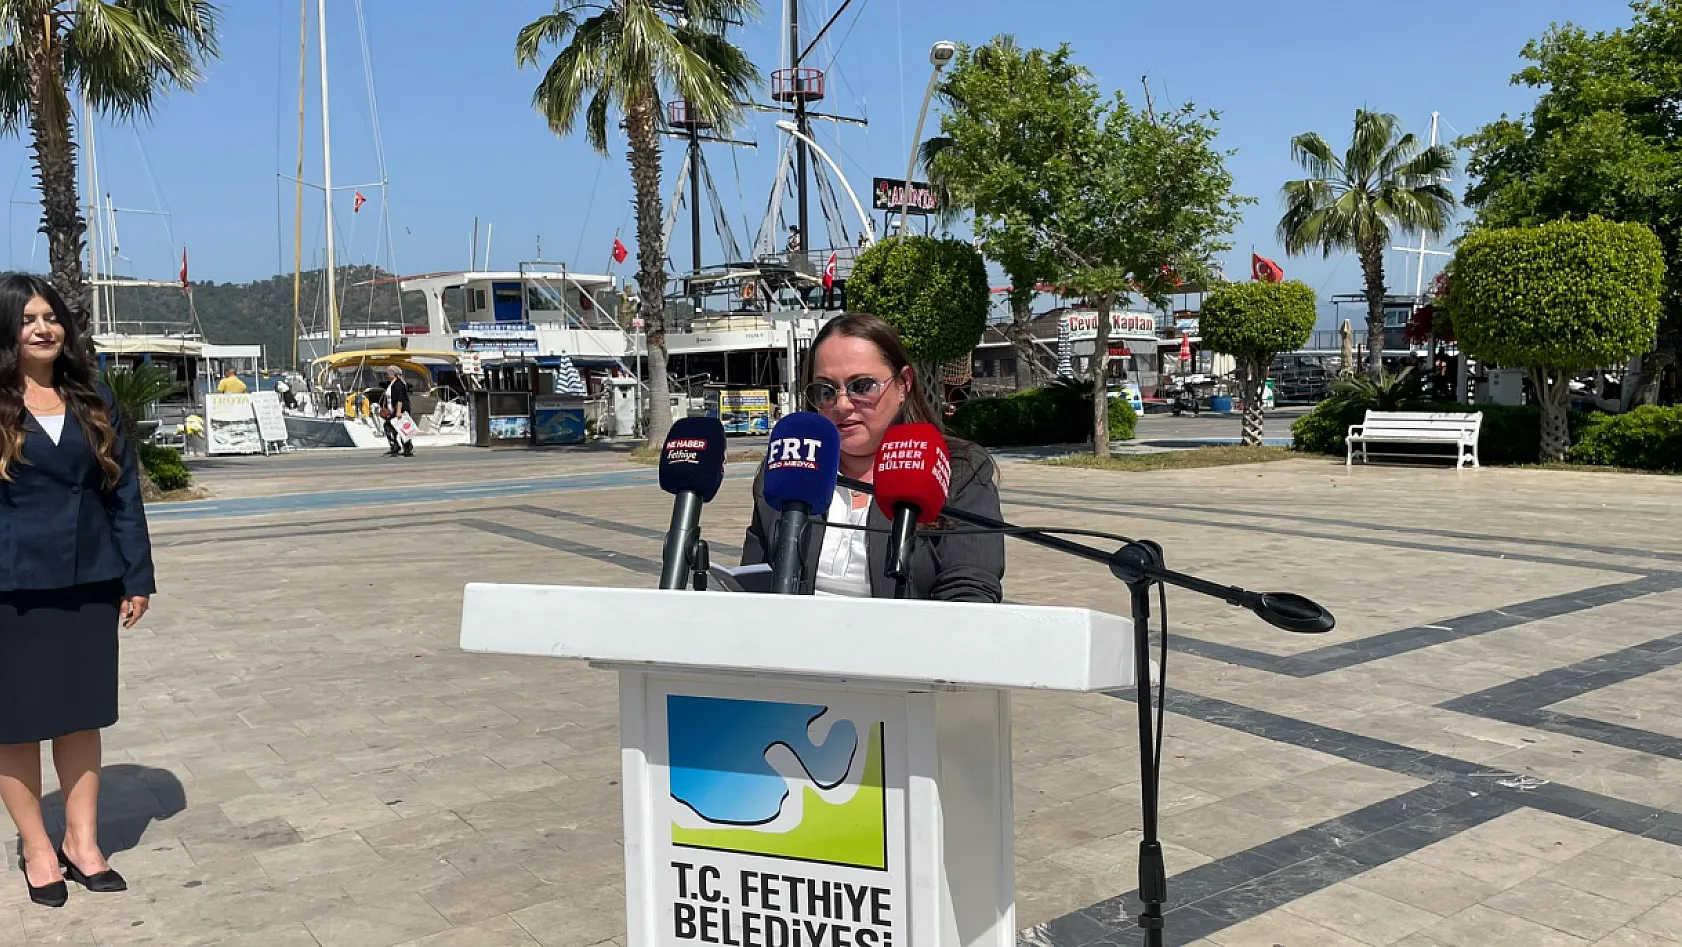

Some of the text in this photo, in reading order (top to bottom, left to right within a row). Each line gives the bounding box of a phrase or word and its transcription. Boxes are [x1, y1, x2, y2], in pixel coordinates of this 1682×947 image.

[677, 440, 705, 448] HABER
[881, 439, 928, 451] FETHİYE
[667, 449, 697, 460] Fethiye
[768, 438, 822, 464] FRT
[882, 450, 922, 460] HABER
[671, 861, 730, 904] T.C.
